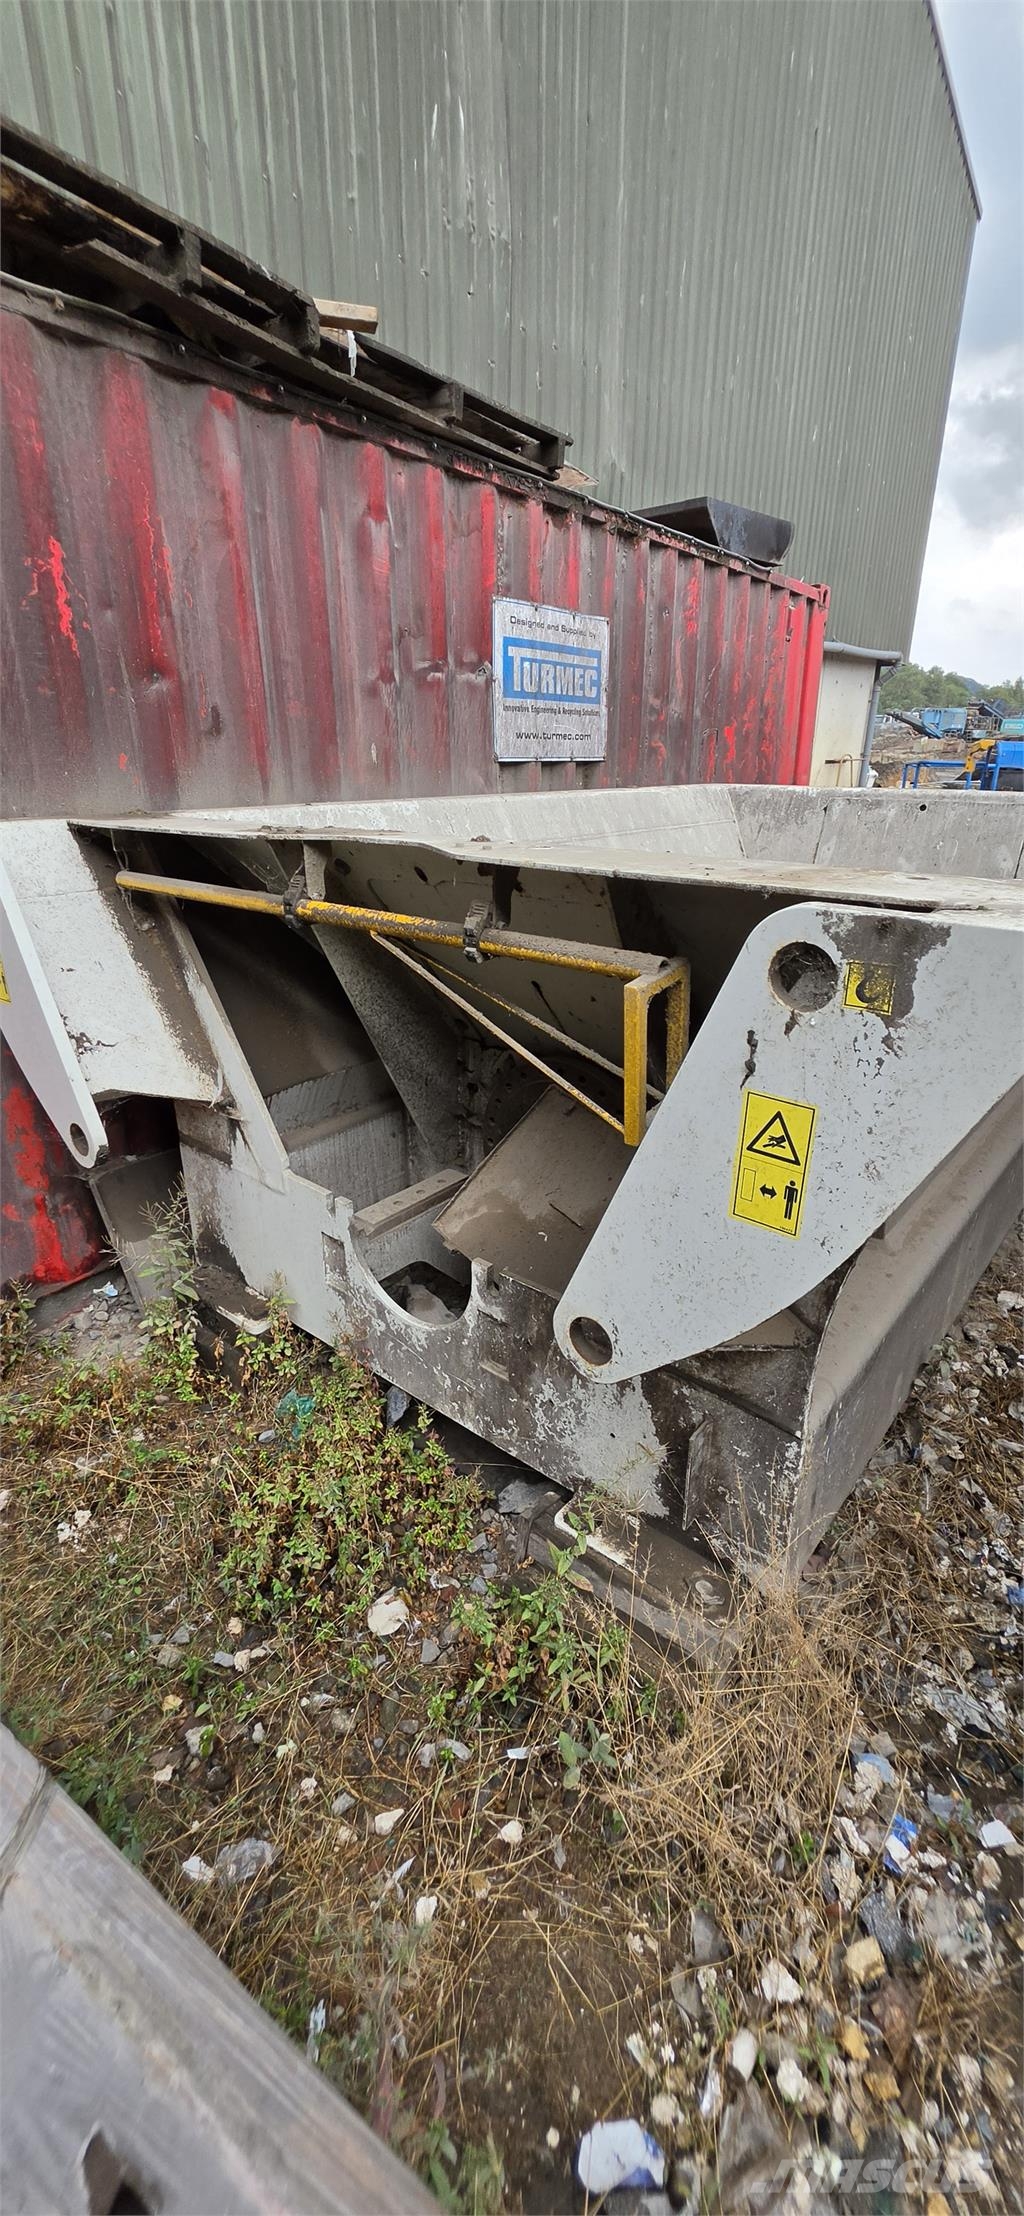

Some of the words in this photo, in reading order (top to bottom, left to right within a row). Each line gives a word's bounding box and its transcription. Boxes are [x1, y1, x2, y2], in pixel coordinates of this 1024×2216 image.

[509, 615, 545, 629] Designed
[546, 624, 560, 632] and
[507, 646, 598, 698] TURMEC
[503, 704, 530, 713] Innovative
[531, 705, 557, 715] Engineering
[562, 707, 581, 717] Recycling
[515, 731, 592, 741] www.turmec.com
